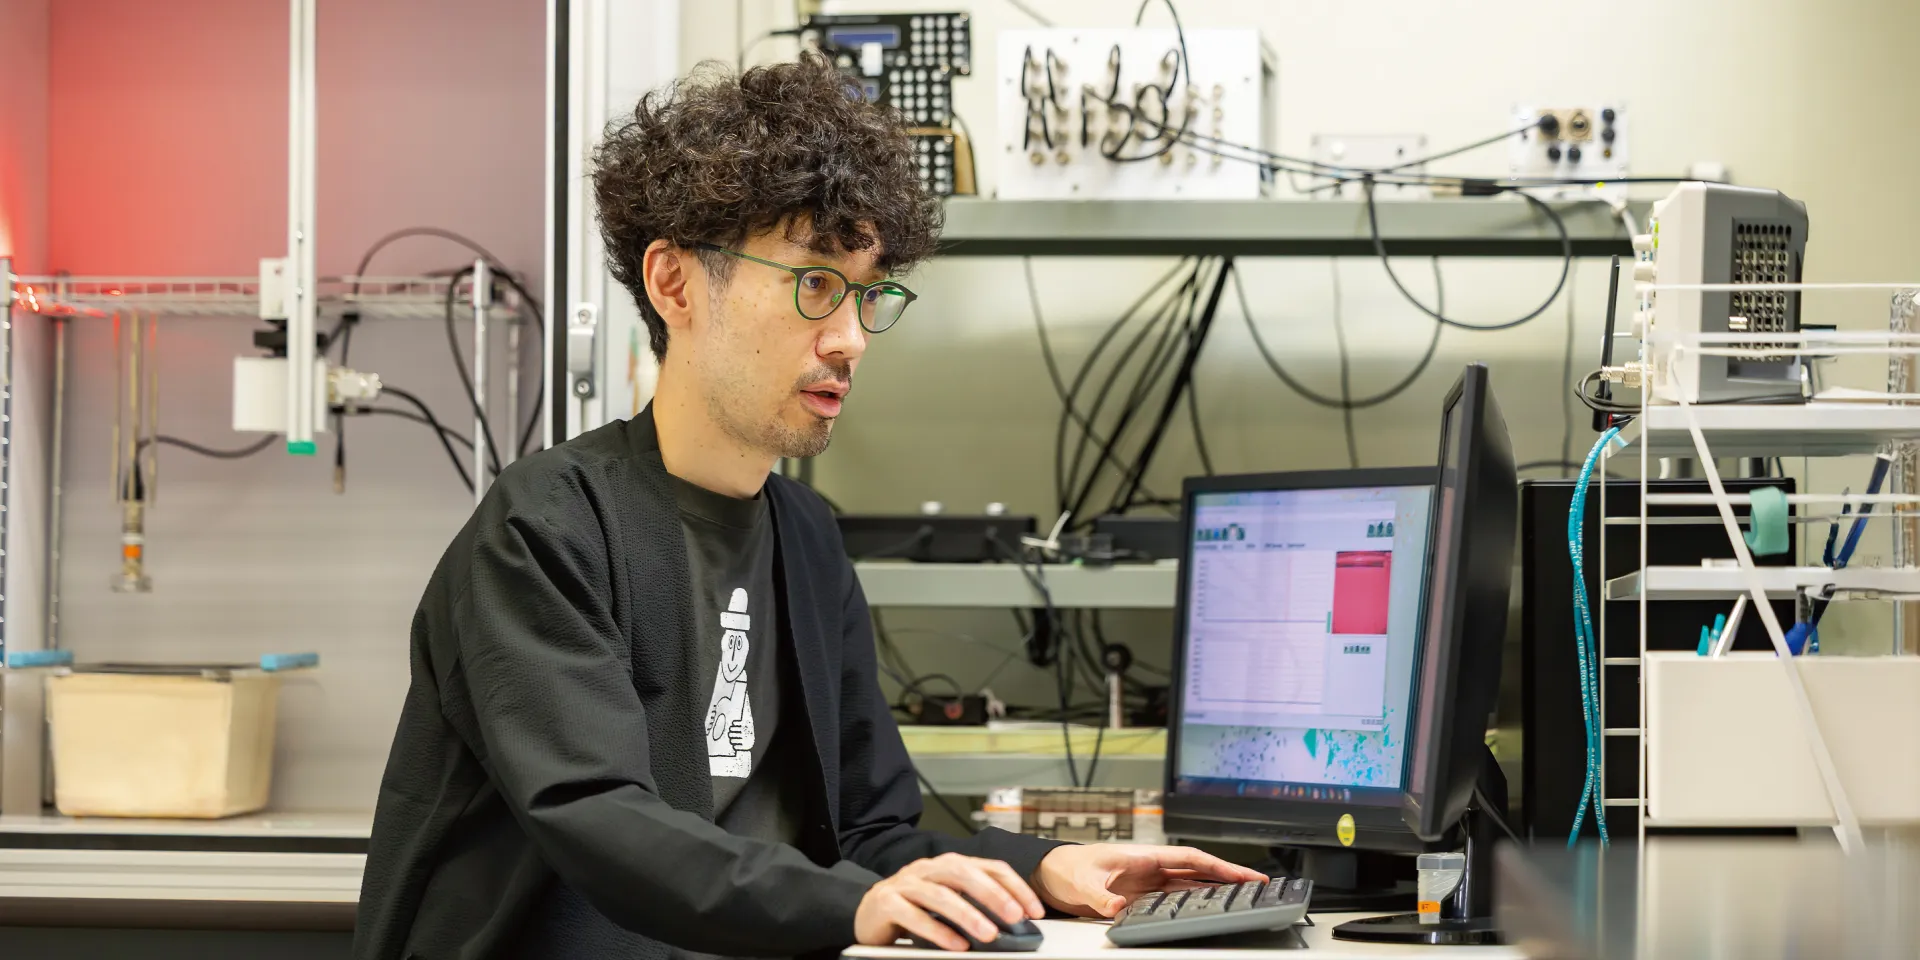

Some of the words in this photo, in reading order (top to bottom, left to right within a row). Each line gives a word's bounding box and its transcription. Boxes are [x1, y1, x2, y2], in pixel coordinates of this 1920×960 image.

[1579, 659, 1587, 691] ACROSS
[1583, 771, 1595, 803] ACROSS
[1572, 812, 1584, 831] LINE
